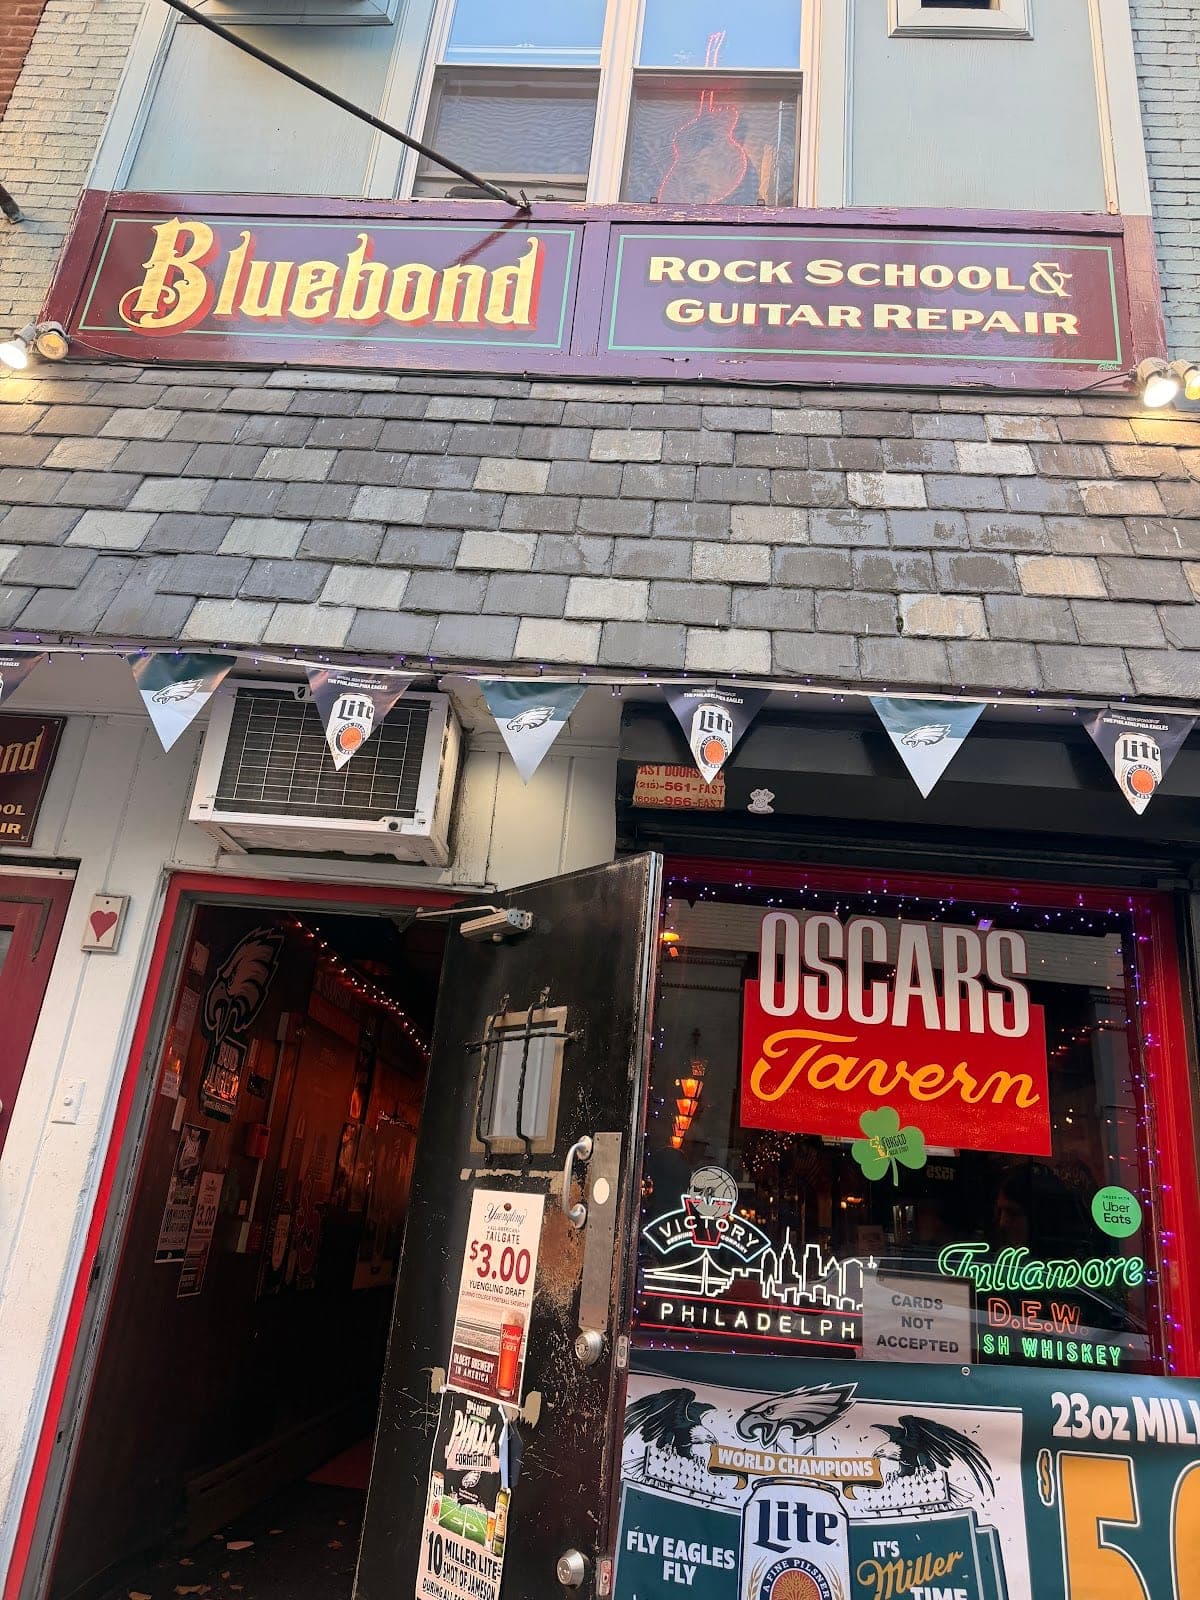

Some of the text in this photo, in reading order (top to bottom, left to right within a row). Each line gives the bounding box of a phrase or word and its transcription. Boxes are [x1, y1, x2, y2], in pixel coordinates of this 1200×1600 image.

[119, 217, 544, 335] Bluebond
[648, 256, 793, 284] ROCK
[665, 298, 1080, 336] GUITAR REPAIR
[337, 699, 374, 721] Lite
[699, 709, 733, 734] Lite
[1122, 739, 1160, 762] Lite
[638, 764, 661, 776] AST
[0, 822, 21, 835] IR
[750, 1029, 1041, 1109] Tavern
[1102, 1201, 1130, 1213] Uber
[1103, 1213, 1132, 1225] Eats
[486, 1231, 520, 1245] TAILGATE
[658, 1215, 760, 1248] VICTORY
[469, 1239, 531, 1285] $3.00
[469, 1279, 526, 1298] YUENGLING DRAFT
[891, 1294, 944, 1311] CARDS
[660, 1302, 856, 1340] PHILADELPH
[901, 1316, 934, 1330] NOT
[876, 1333, 960, 1354] ACCEPTED
[977, 1332, 1121, 1367] SH WHISKEY
[462, 1367, 489, 1384] AMERICA
[1051, 1391, 1131, 1441] 23oz
[716, 1447, 875, 1478] WORLD CHAMPIONS
[752, 1499, 839, 1554] Lite
[444, 1538, 477, 1570] MILLER
[478, 1554, 498, 1581] LITE
[626, 1530, 736, 1570] FLY EAGLES
[872, 1540, 900, 1558] IT'S
[442, 1561, 459, 1583] SHOT
[459, 1569, 468, 1588] OF
[663, 1560, 697, 1586] FLY
[762, 1559, 830, 1599] A FINE PILSNER
[856, 1551, 964, 1600] Miller
